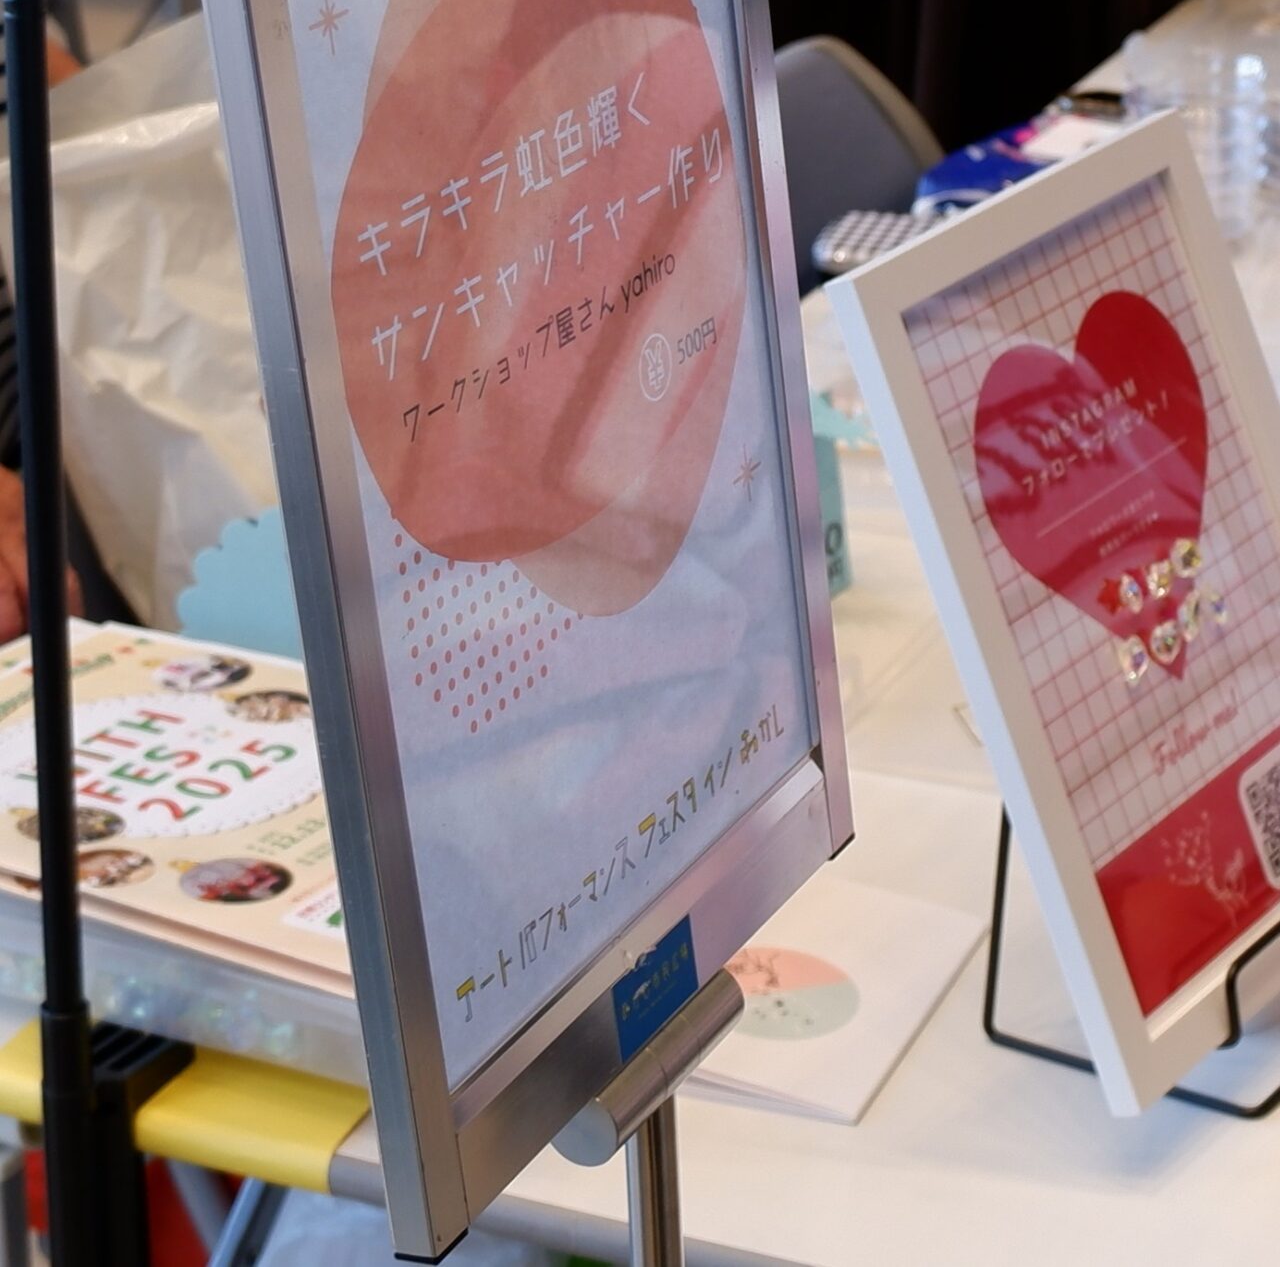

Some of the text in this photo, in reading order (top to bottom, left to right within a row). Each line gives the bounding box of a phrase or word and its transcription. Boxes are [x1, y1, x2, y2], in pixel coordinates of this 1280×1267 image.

[357, 72, 650, 276] キラキラ虹色輝く
[371, 128, 724, 381] サンキャッチャー作り
[402, 252, 676, 443] ワークショップ屋さん yahiro
[676, 317, 718, 365] 500円
[1041, 378, 1138, 450] INSTAGRAM
[138, 739, 297, 823] 2025
